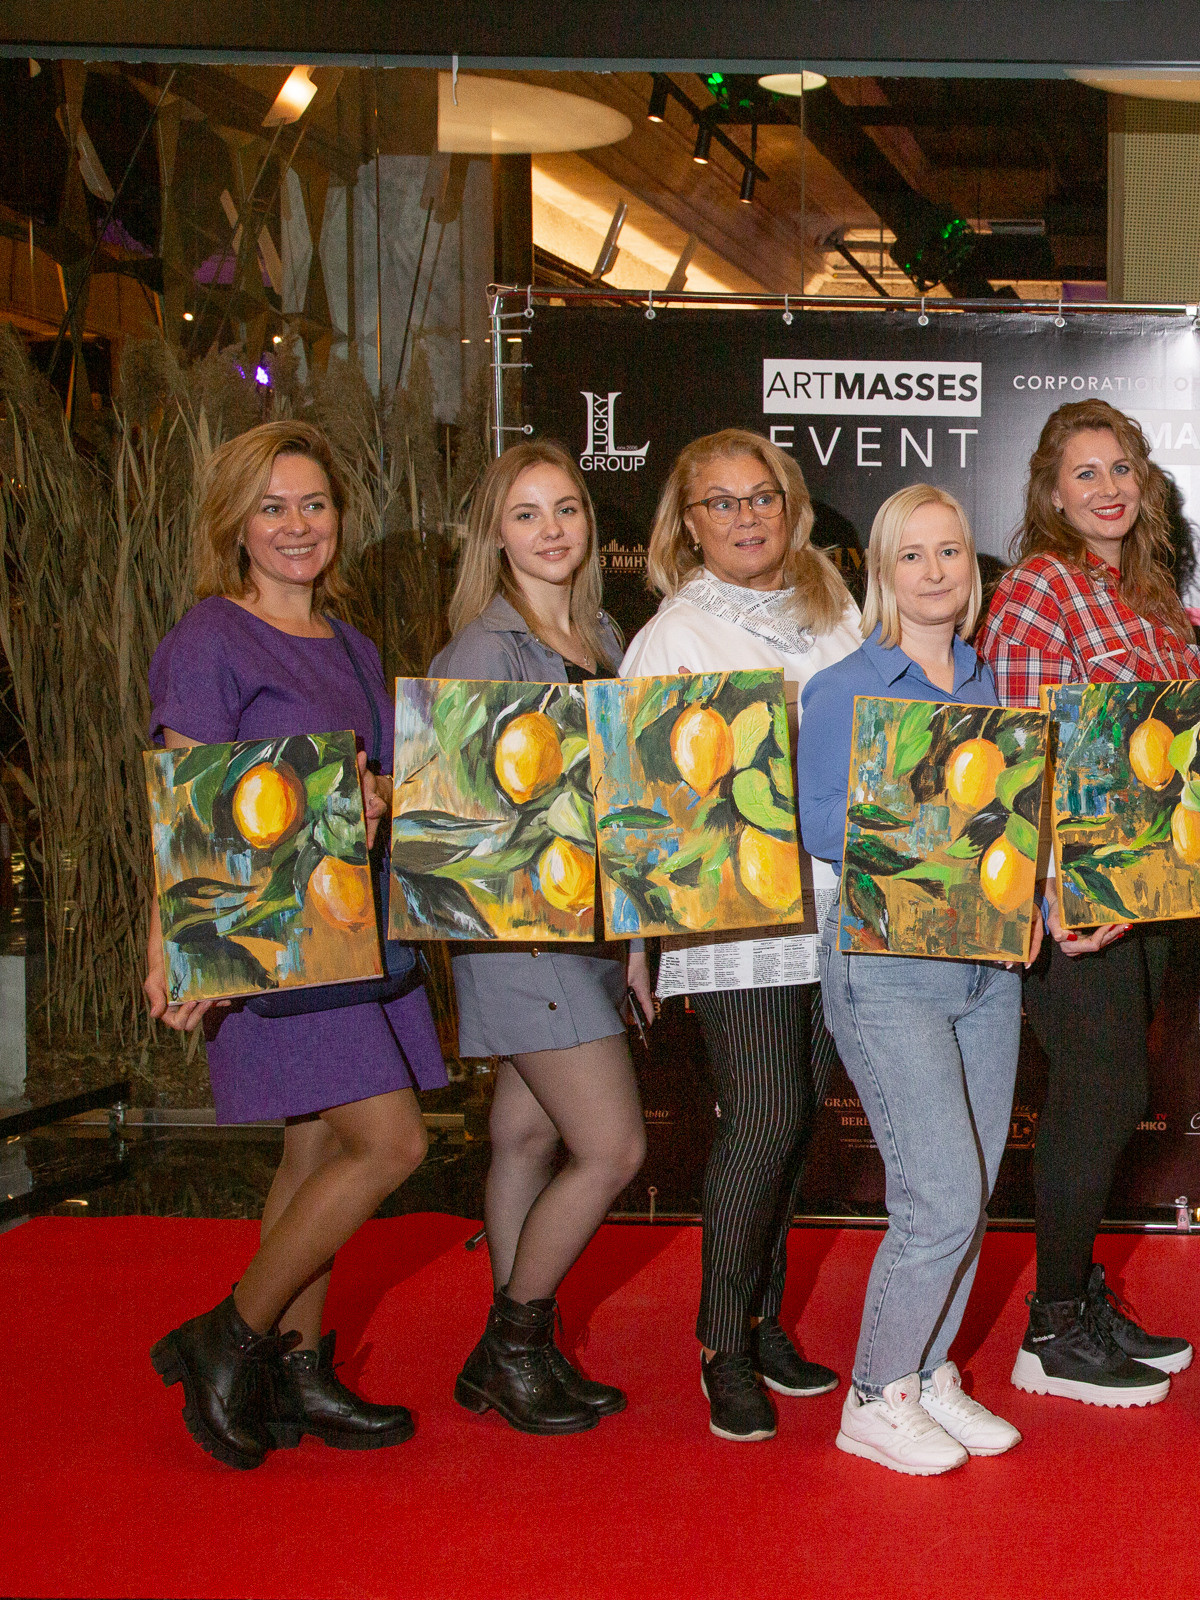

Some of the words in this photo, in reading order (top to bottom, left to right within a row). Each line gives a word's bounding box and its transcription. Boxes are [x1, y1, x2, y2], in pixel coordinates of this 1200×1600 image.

[766, 371, 978, 402] ARTMASSES
[1013, 375, 1165, 391] CORPORATION
[594, 393, 608, 455] LUCKY
[769, 425, 979, 468] EVENT
[579, 456, 646, 471] GROUP
